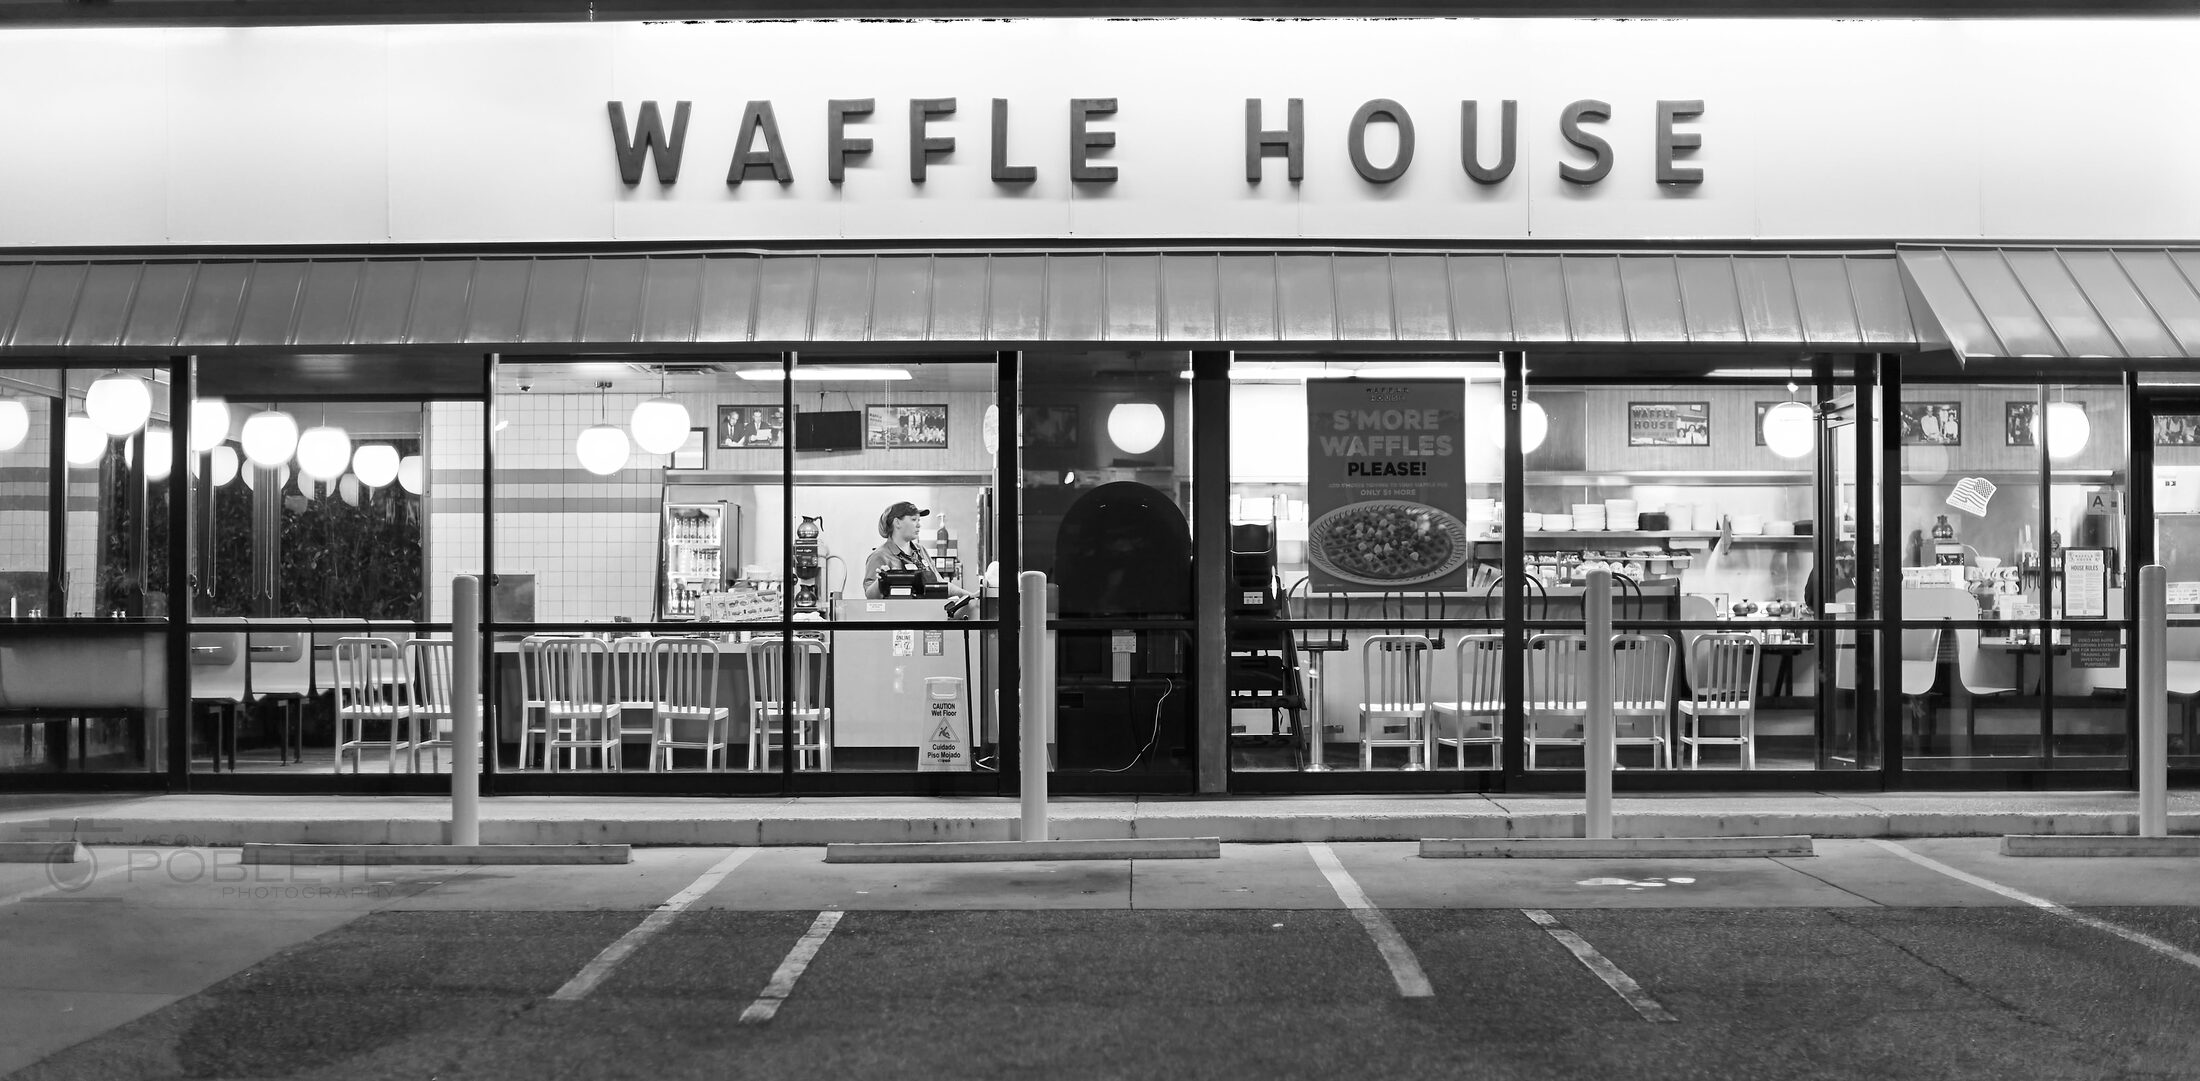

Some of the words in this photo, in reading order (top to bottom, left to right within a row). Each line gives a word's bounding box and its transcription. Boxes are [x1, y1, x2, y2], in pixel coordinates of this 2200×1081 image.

[607, 97, 1119, 185] WAFFLE
[1245, 97, 1706, 185] HOUSE
[1333, 409, 1440, 431] S'MORE
[1632, 409, 1676, 419] WAFFLE
[1633, 421, 1675, 430] HOUSE
[1319, 435, 1453, 457] WAFFLES
[1347, 461, 1427, 477] PLEASE!
[2092, 495, 2104, 508] A
[932, 743, 956, 751] Cuidado
[927, 751, 940, 759] Piso
[940, 751, 961, 760] Mojado
